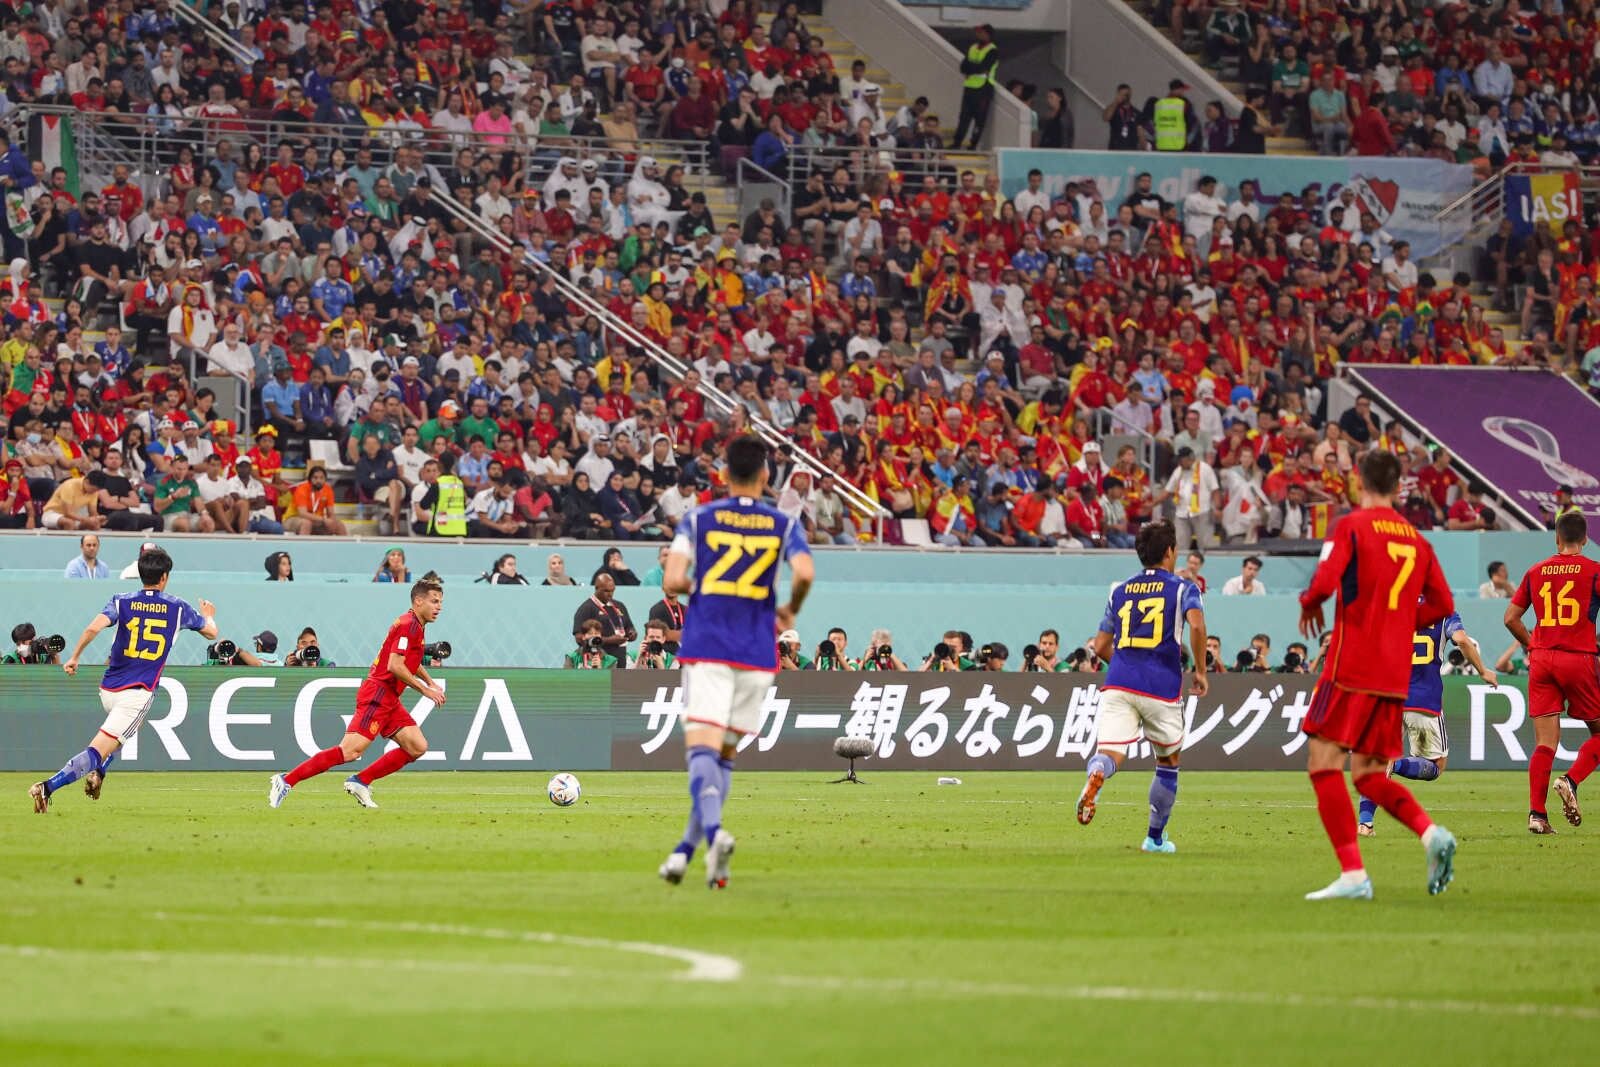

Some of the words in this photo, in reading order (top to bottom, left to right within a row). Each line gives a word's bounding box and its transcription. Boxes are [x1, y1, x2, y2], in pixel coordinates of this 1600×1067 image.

[701, 530, 781, 600] 22
[1124, 581, 1165, 594] MORITA
[1387, 541, 1416, 610] 7
[1541, 564, 1581, 576] RODRIGO
[130, 600, 168, 614] KAMADA
[1117, 597, 1166, 650] 13
[1539, 580, 1580, 627] 16
[123, 616, 168, 661] 15
